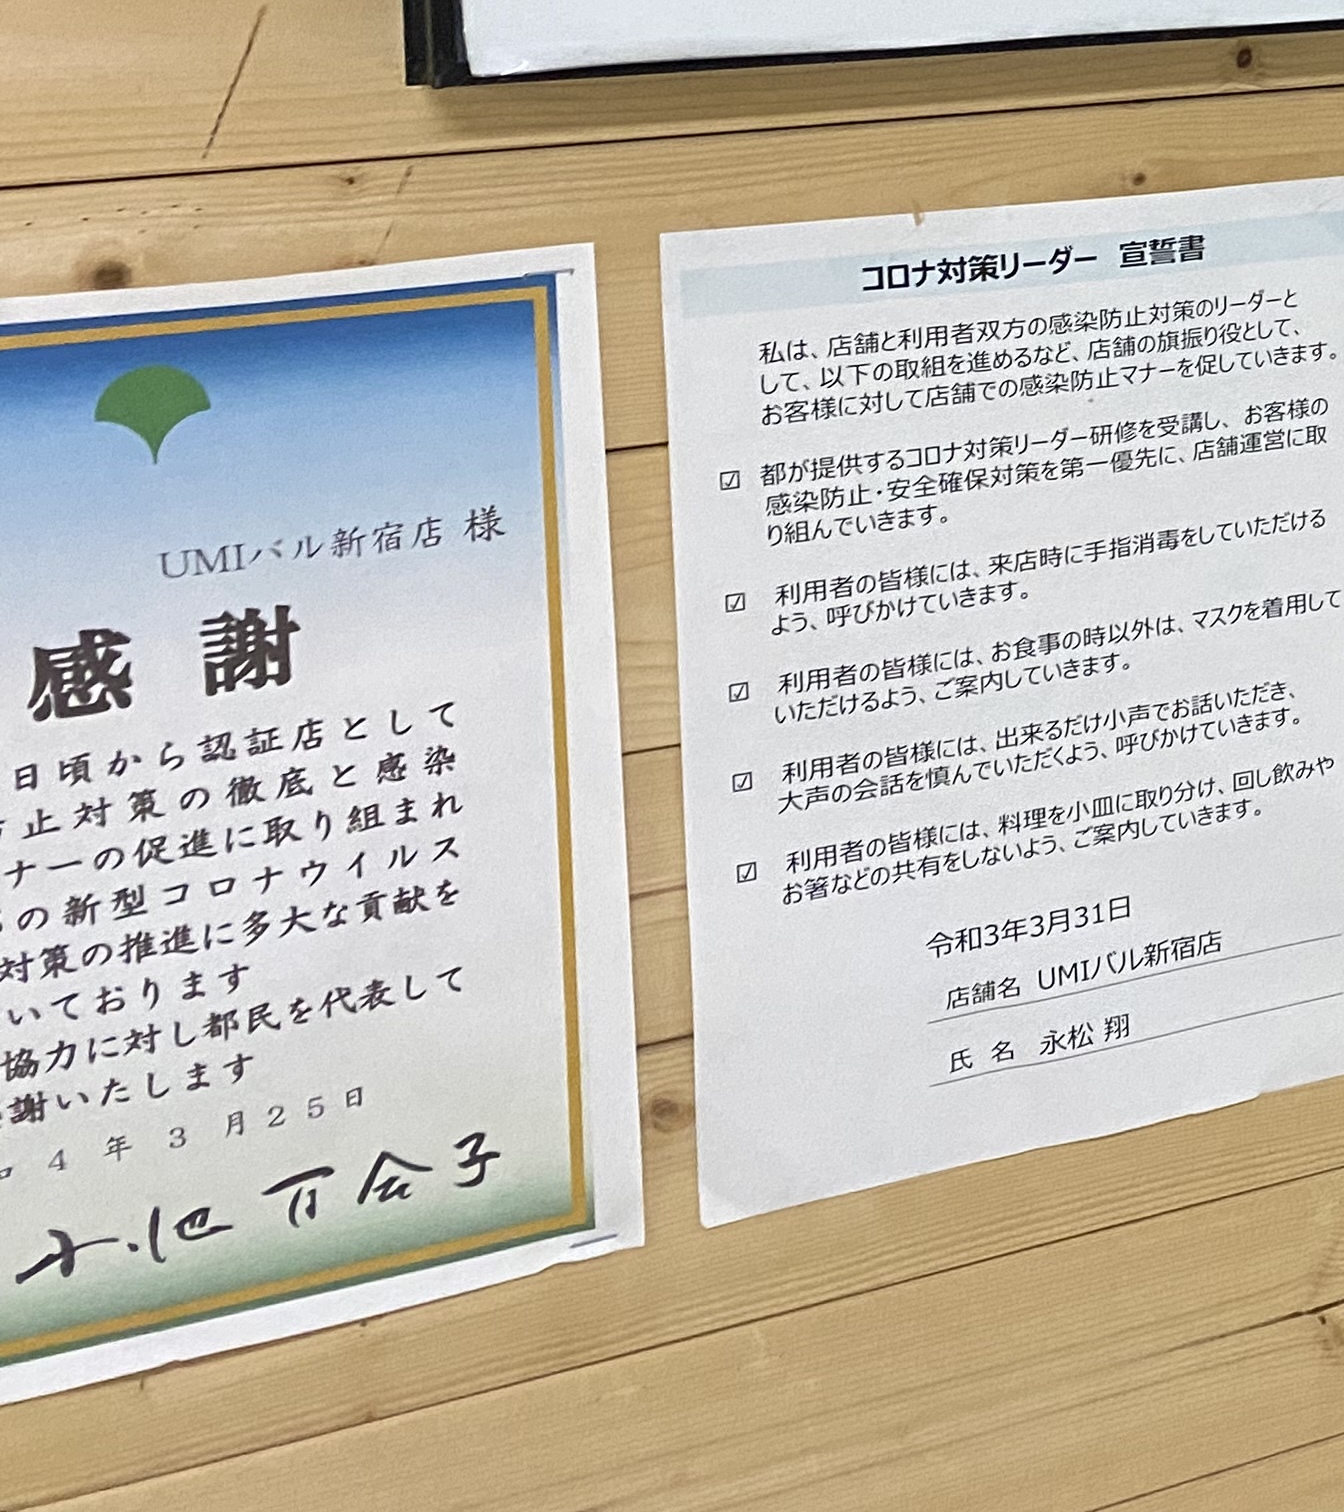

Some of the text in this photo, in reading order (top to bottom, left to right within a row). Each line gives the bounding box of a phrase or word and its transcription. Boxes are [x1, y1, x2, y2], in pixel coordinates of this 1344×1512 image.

[862, 235, 1205, 291] コロナ対策リーダー 宣誓書
[759, 289, 1298, 363] 私は、店舗と利用者双方の感染防止対策のリーダーと
[760, 317, 1303, 394] して、以下の取組を進めるなど、店舗の旗振り役として、
[760, 345, 1338, 426] お客様に対して店舗での感染防止マナーを促していきます。
[765, 424, 1327, 516] 感染防止・安全確保対策を第一優先に、店舗運営に取
[157, 505, 505, 580] UMIバル新宿店 様
[767, 512, 950, 546] り組んでいきます。
[776, 508, 1326, 606] 利用者の皆様には、来店時に手指消毒をしていただける
[770, 585, 1030, 637] よう、呼びかけていきます。
[778, 588, 1343, 695] 利用者の皆様には、お食事の時以外は、マスクを着用して
[773, 658, 1132, 726] いただけるよう、ご案内していきます。
[12, 701, 458, 791] 日頃から認証店として
[778, 708, 1302, 815] 大声の会話を慎んでいただくよう、呼びかけていきます。
[782, 680, 1296, 786] 利用者の皆様には、出来るだけ小声でお話いただき、
[0, 745, 457, 839] 止対策の徹底と感染
[786, 757, 1334, 875] 利用者の皆様には、料理を小皿に取り分け、回し飲みや
[0, 837, 460, 933] の新型コロナウイルス
[782, 802, 1263, 907] お箸などの共有をしないよう、ご案内していきます。
[925, 896, 1132, 958] 令和3年3月31日
[8, 962, 250, 1025] いております
[946, 931, 1223, 1012] 店舗名 UMIバル新宿店
[0, 1052, 255, 1129] 謝いたします
